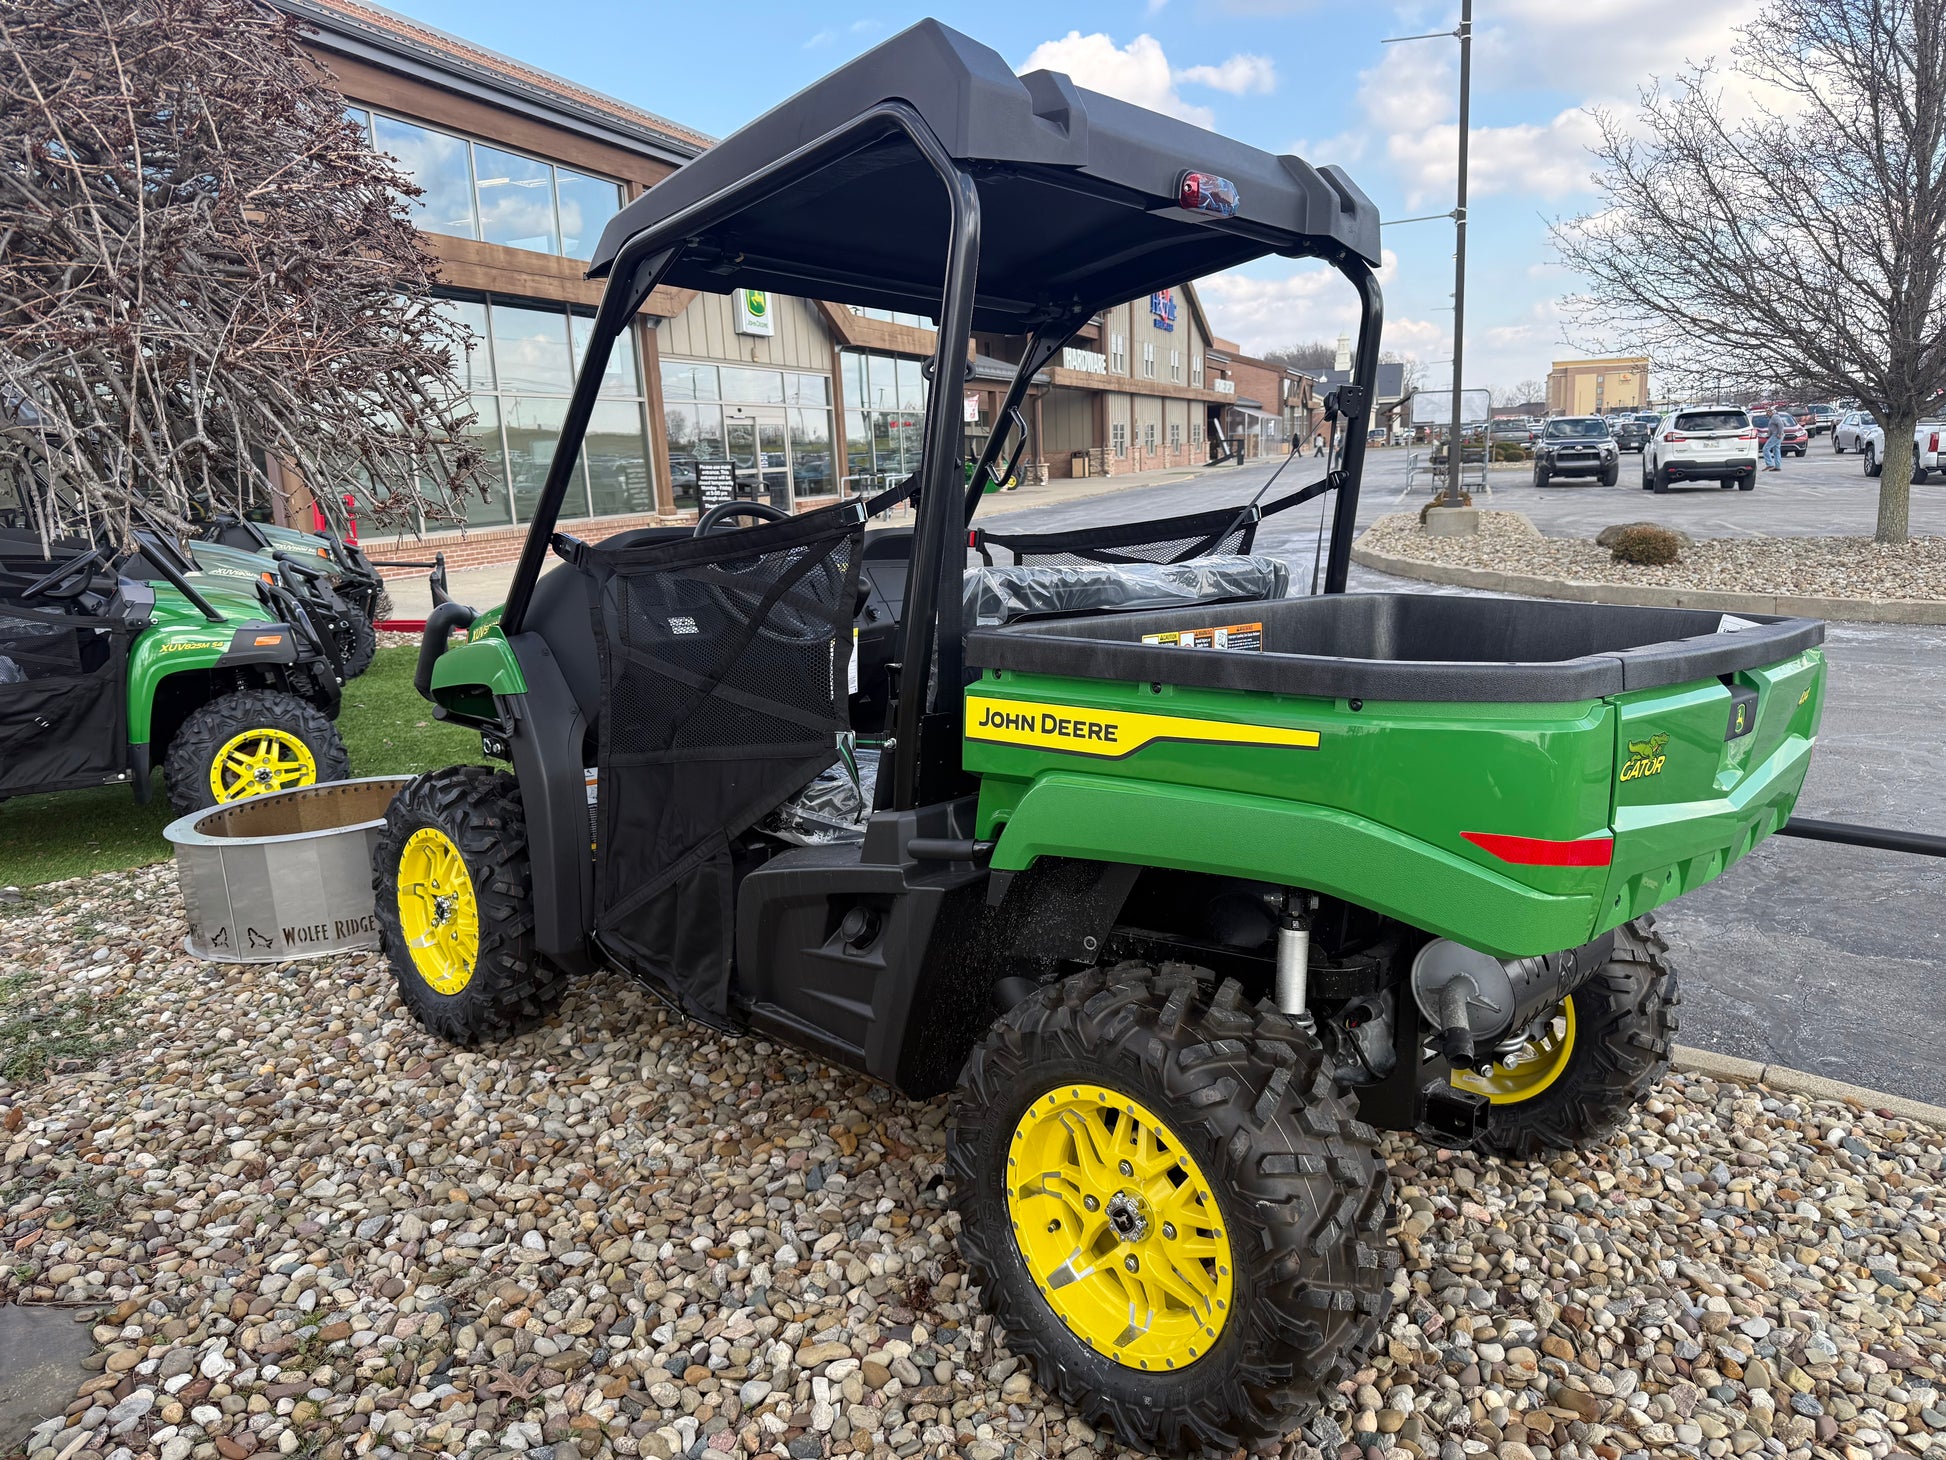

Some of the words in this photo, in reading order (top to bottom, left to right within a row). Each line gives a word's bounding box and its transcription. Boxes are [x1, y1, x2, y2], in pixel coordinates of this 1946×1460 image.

[1062, 346, 1106, 375] HARDWARE
[159, 642, 210, 653] XUV825M
[978, 707, 1036, 733] JOHN
[1041, 713, 1119, 743] DEERE
[1620, 755, 1666, 781] GATOR
[282, 924, 329, 947] WOLFE
[334, 915, 376, 939] RIDGE
